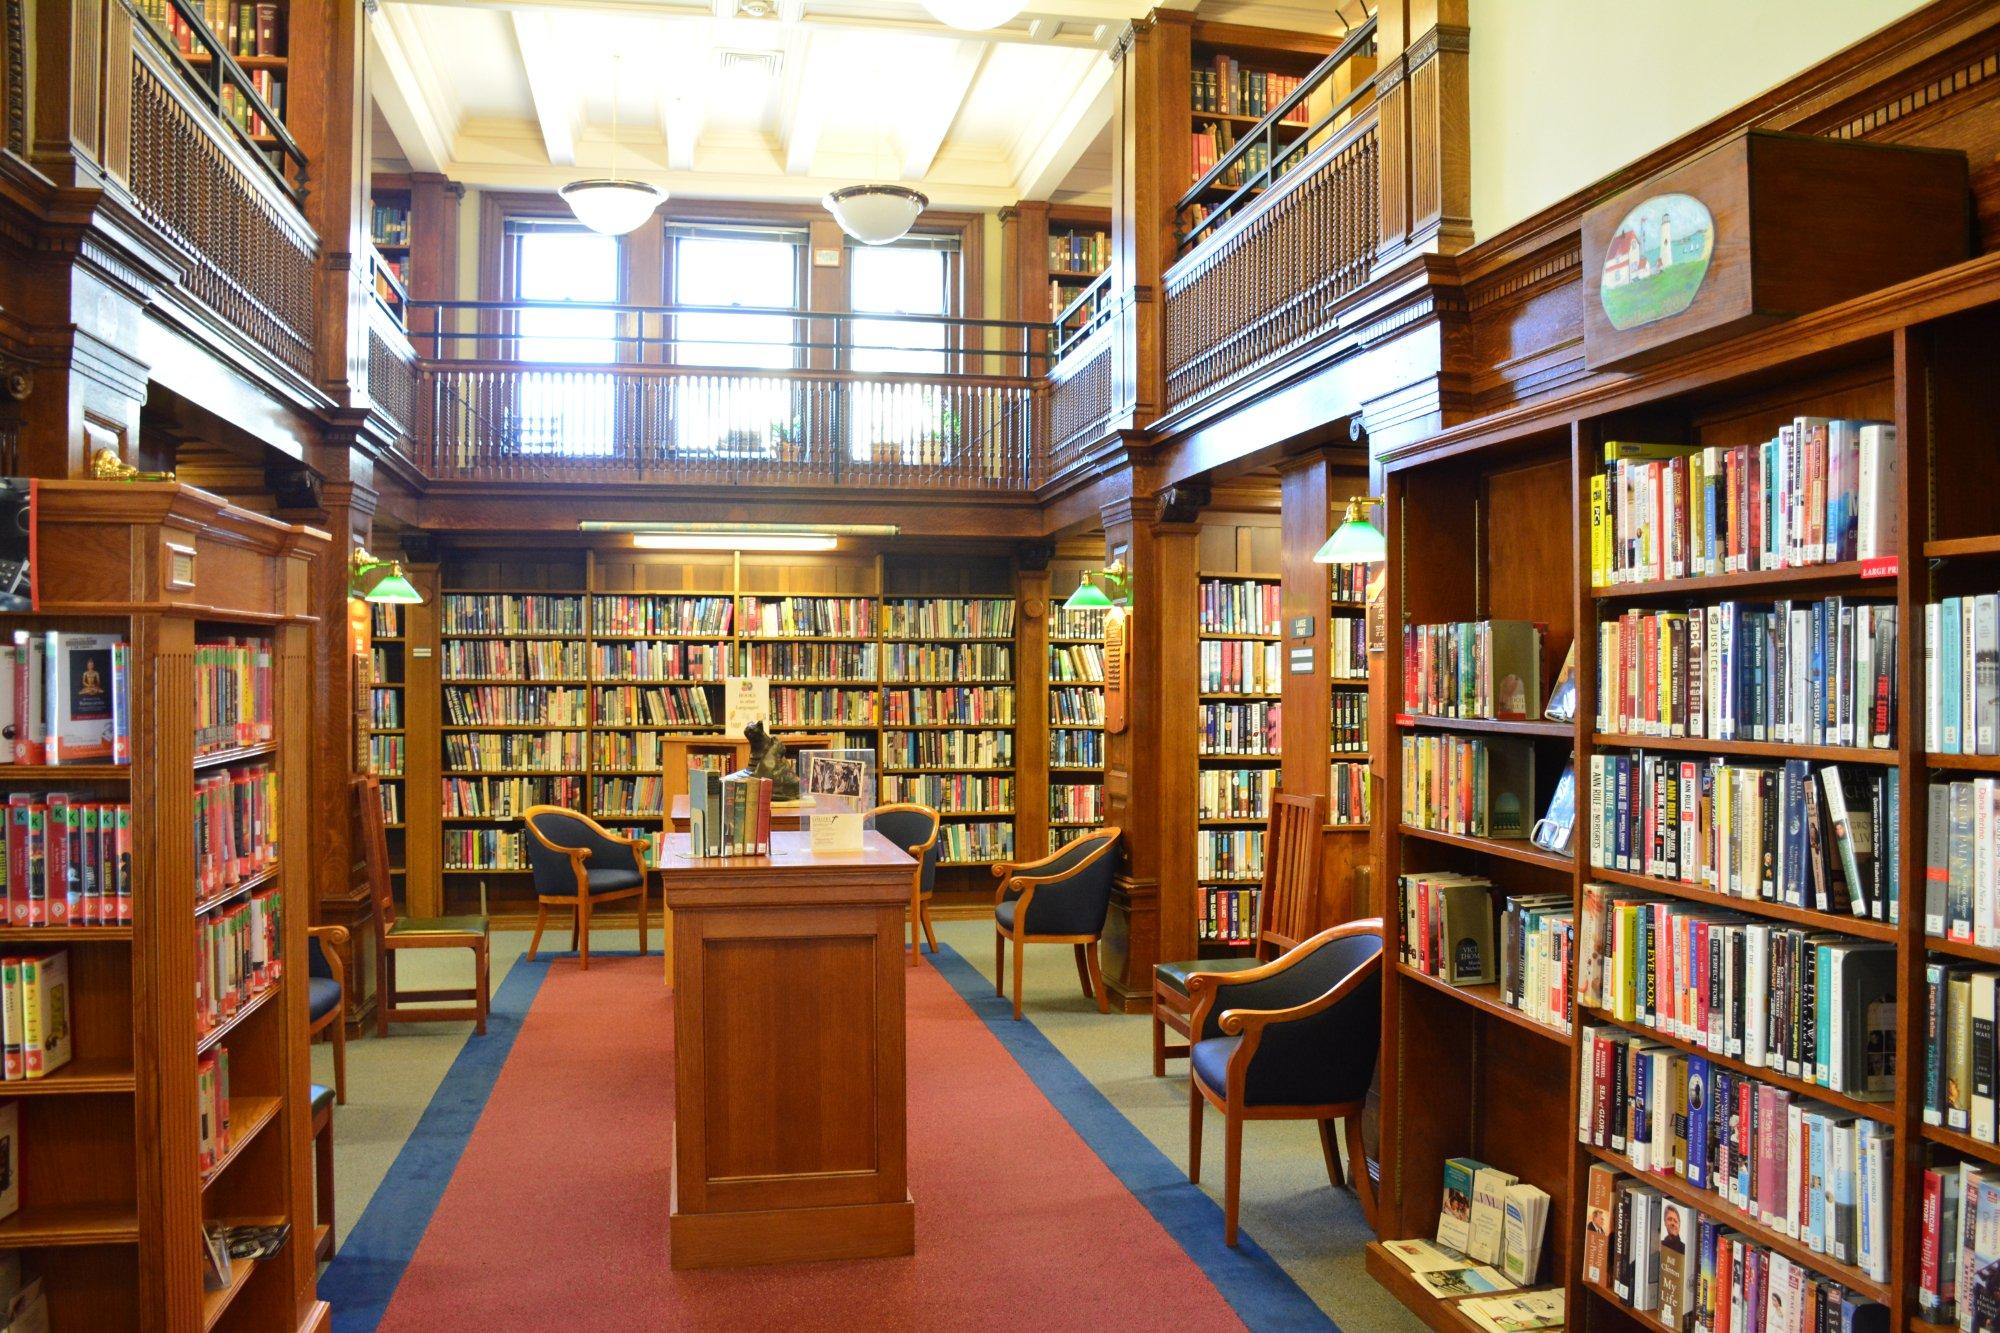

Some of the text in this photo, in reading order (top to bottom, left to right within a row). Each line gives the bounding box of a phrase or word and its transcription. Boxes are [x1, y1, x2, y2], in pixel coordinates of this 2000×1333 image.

[1863, 568, 1886, 576] LARGE
[1827, 602, 1837, 722] MICHAEL CONNELLY CRIME BEAT
[1876, 700, 1888, 732] LOVER
[1592, 771, 1601, 806] ANN RULE
[1606, 775, 1614, 810] ANN RULE
[1618, 772, 1627, 800] ANN RULE
[1666, 780, 1676, 826] ANN RULE
[1978, 787, 1987, 810] Dana
[17, 811, 25, 821] K
[31, 818, 38, 827] K
[55, 809, 62, 818] K
[69, 813, 75, 823] K
[87, 814, 93, 823] K
[103, 814, 110, 823] K
[1594, 813, 1601, 823] NO
[1657, 825, 1664, 836] ME
[1958, 787, 1968, 870] SARAH PALIN
[1978, 813, 1987, 840] Perino
[1647, 930, 1655, 1007] THE EYE BOOK
[1711, 939, 1720, 1008] THE PERFECT STORM
[1808, 950, 1816, 1059] I'LL FLY AWAY
[1927, 1045, 1936, 1067] Frank
[1662, 1278, 1677, 1292] My
[1661, 1291, 1678, 1307] Life
